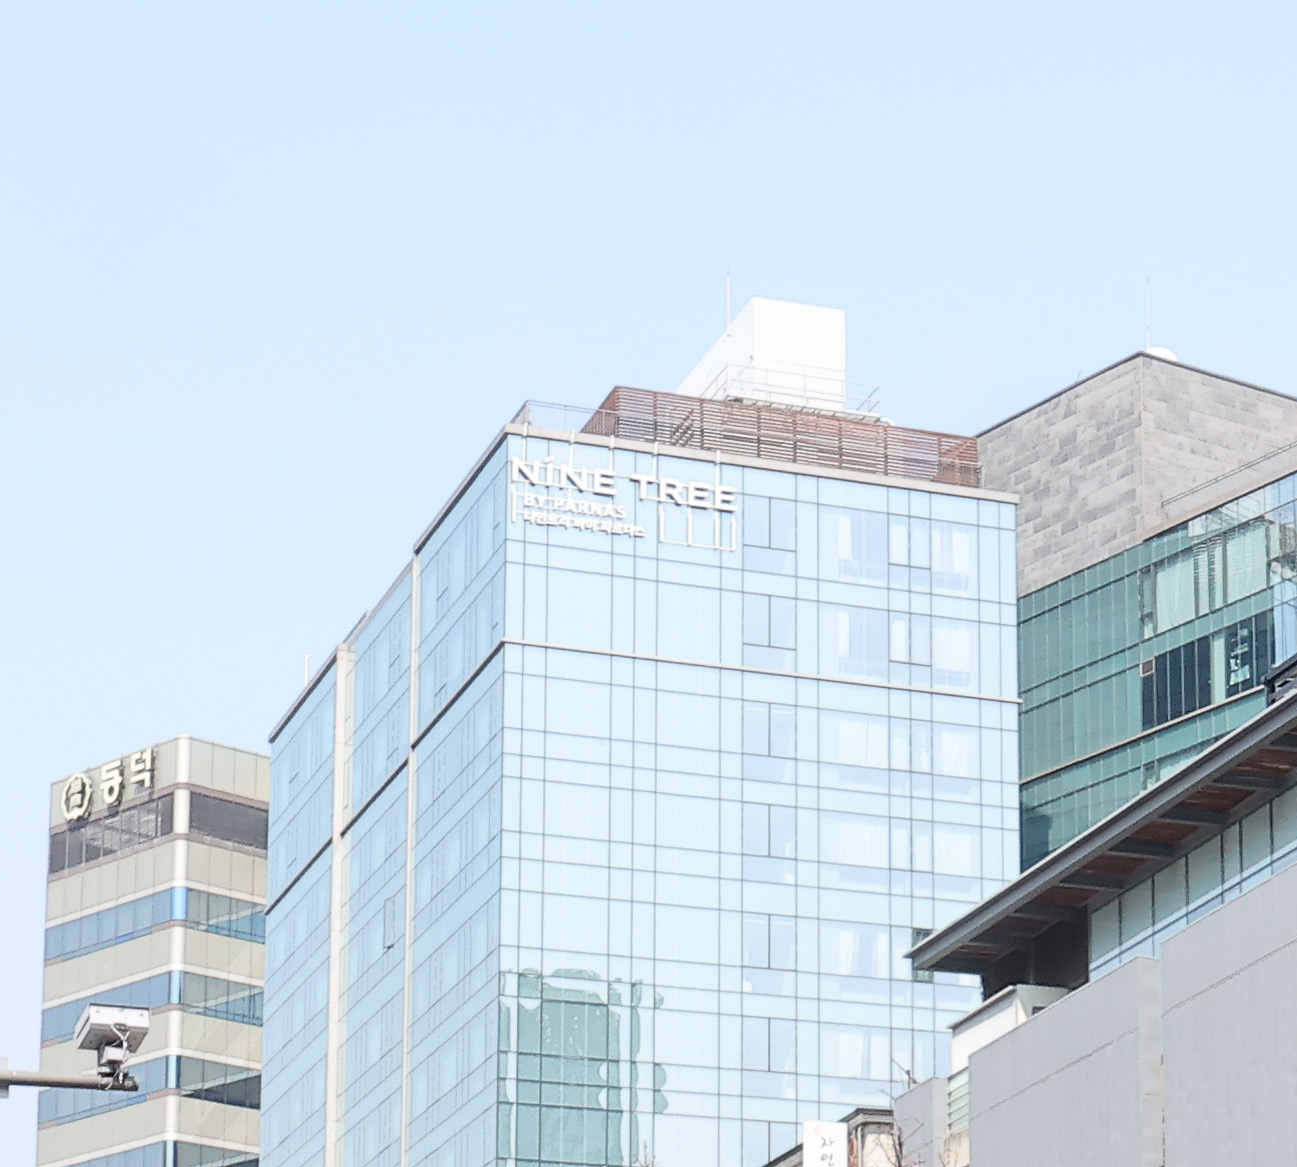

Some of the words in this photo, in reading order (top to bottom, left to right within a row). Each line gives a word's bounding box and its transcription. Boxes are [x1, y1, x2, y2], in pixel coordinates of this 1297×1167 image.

[512, 455, 618, 496] NINE
[630, 473, 739, 513] TREE
[524, 492, 546, 508] BY
[553, 499, 627, 520] PARNAS
[100, 748, 155, 805] 동덕
